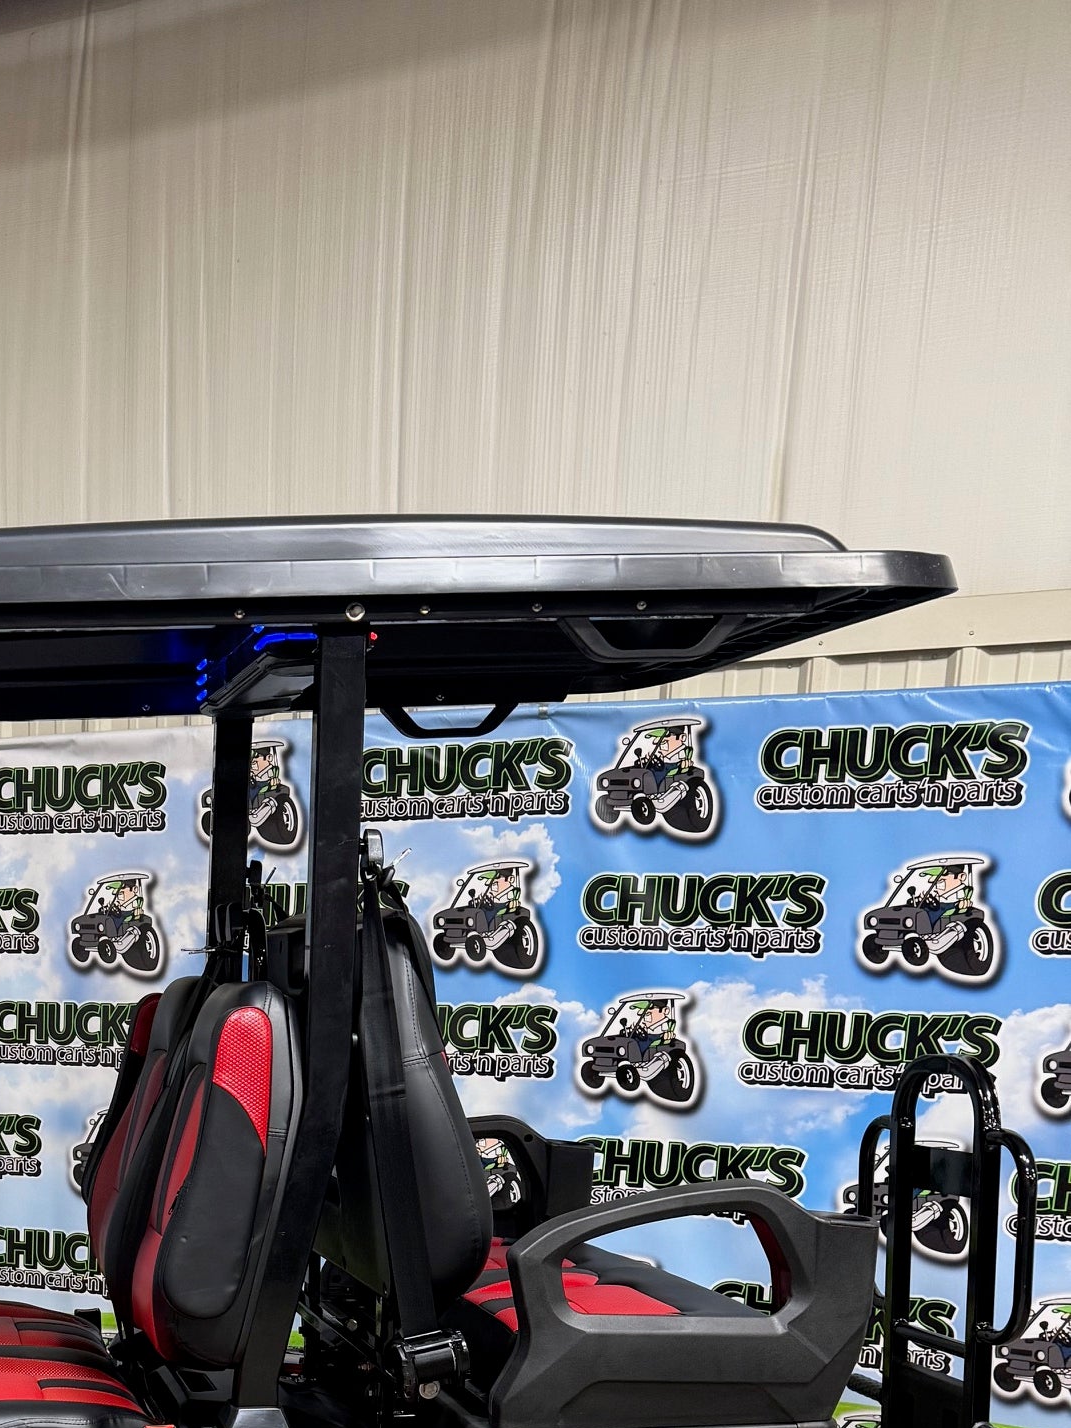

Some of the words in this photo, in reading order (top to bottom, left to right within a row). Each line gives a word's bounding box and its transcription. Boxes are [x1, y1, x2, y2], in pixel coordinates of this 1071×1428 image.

[362, 738, 572, 797] CHUCK'S
[761, 722, 1029, 783] CHUCK'S
[509, 791, 568, 821] parts
[758, 782, 855, 809] custom
[947, 778, 1023, 812] parts
[116, 809, 166, 836] parts
[583, 874, 825, 927] CHUCK'S
[580, 926, 667, 949] custom
[752, 928, 820, 958] parts
[743, 1010, 1002, 1067] CHUCK'S
[495, 1054, 554, 1081] parts
[739, 1061, 834, 1088] custom
